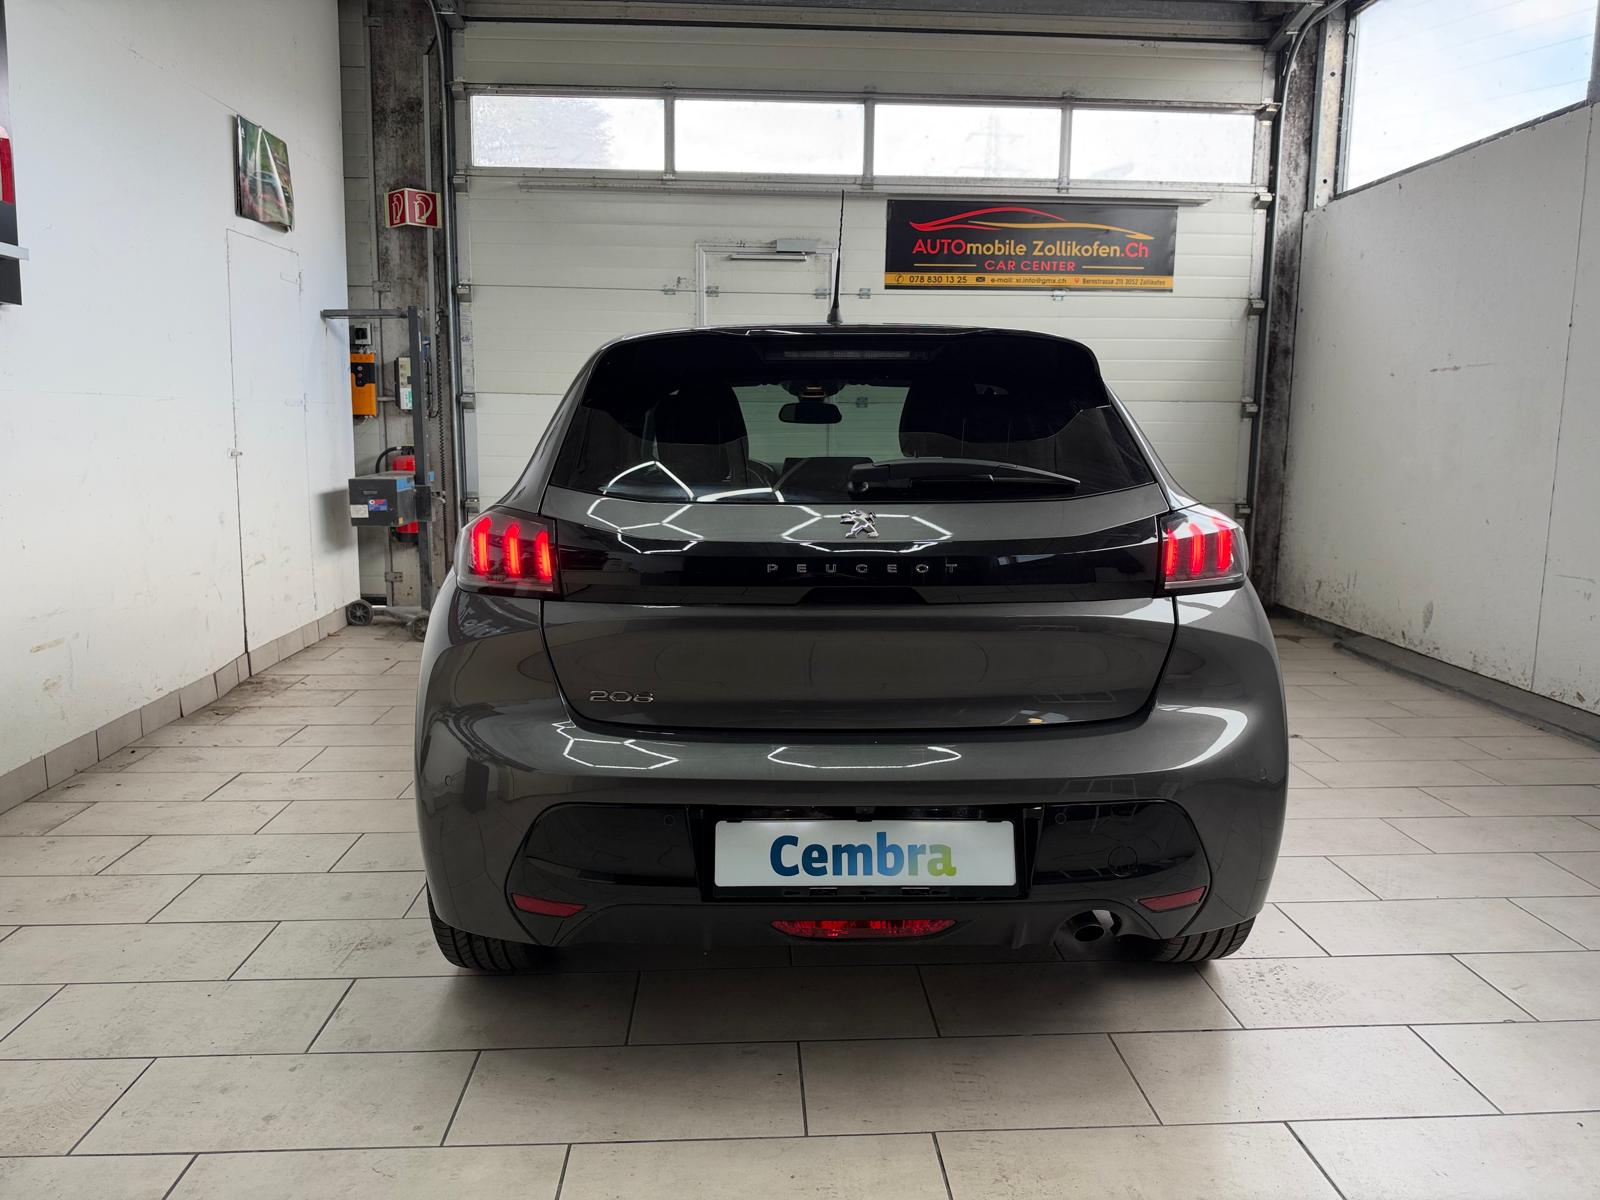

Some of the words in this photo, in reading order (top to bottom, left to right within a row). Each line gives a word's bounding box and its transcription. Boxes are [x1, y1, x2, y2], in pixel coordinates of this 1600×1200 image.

[912, 239, 1027, 255] AUTOmobile
[1032, 240, 1149, 257] Zollikofen.Ch
[984, 260, 1016, 270] CAR
[1021, 260, 1076, 271] CENTER
[908, 275, 925, 283] 078
[927, 275, 943, 283] 830
[946, 275, 955, 283] 13
[957, 275, 968, 283] 25
[766, 563, 958, 573] PEUGEOT
[590, 690, 654, 702] 208
[770, 832, 957, 877] Cembra
